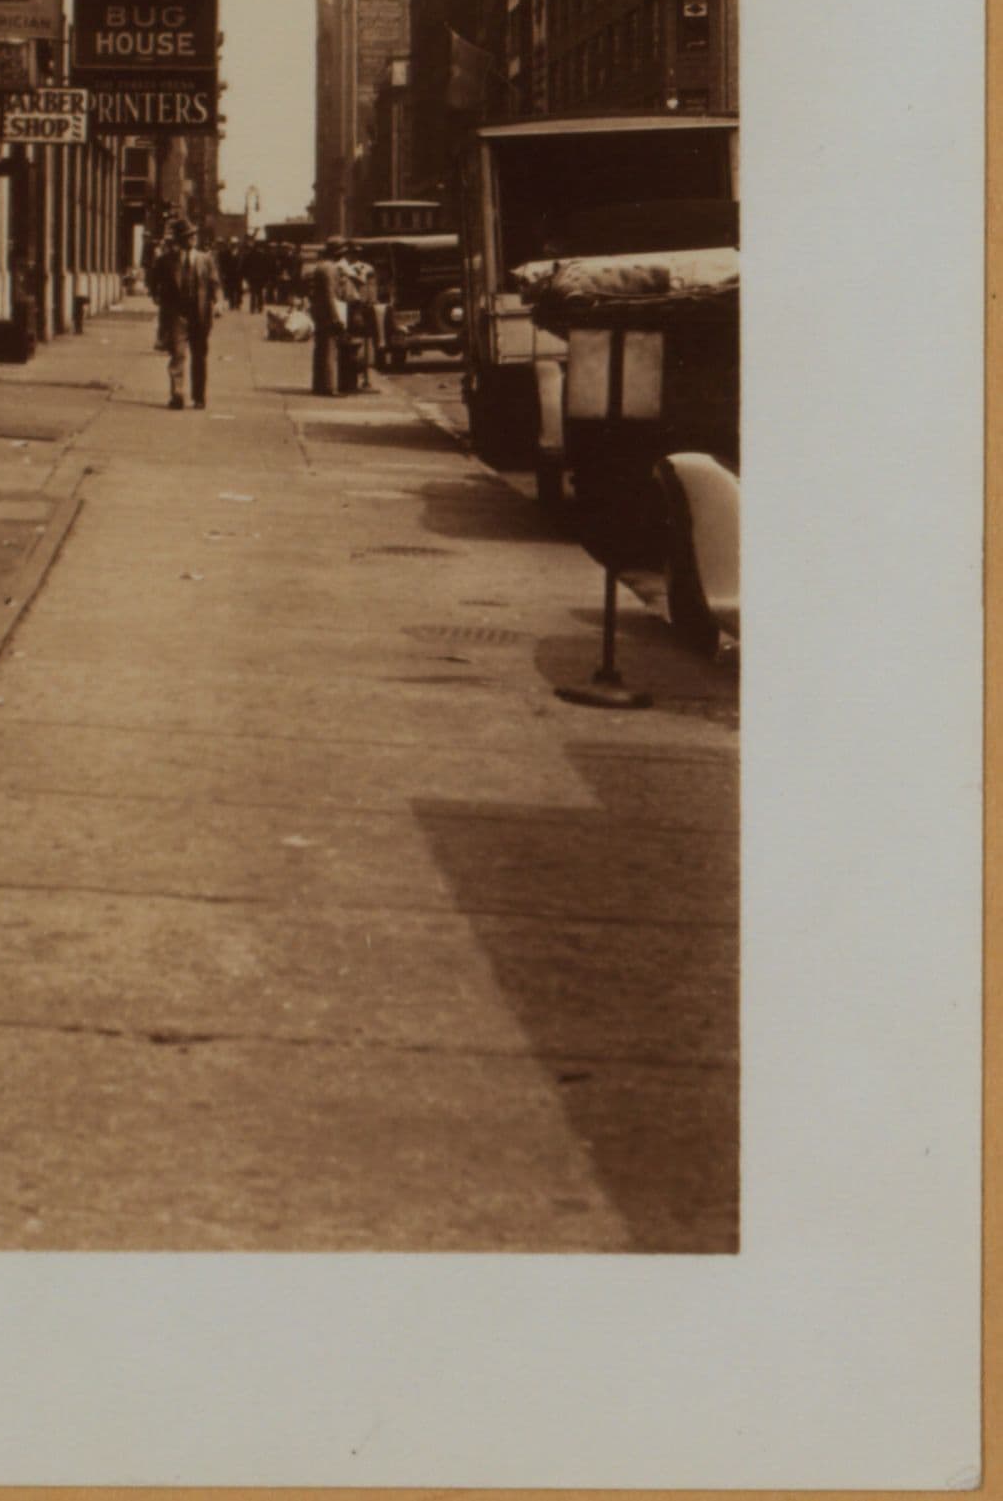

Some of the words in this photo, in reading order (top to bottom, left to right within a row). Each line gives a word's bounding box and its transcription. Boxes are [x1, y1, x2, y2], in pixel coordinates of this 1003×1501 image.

[105, 5, 187, 29] BUG
[94, 31, 197, 57] HOUSE
[5, 91, 85, 114] ARBER
[9, 117, 70, 138] SHOP
